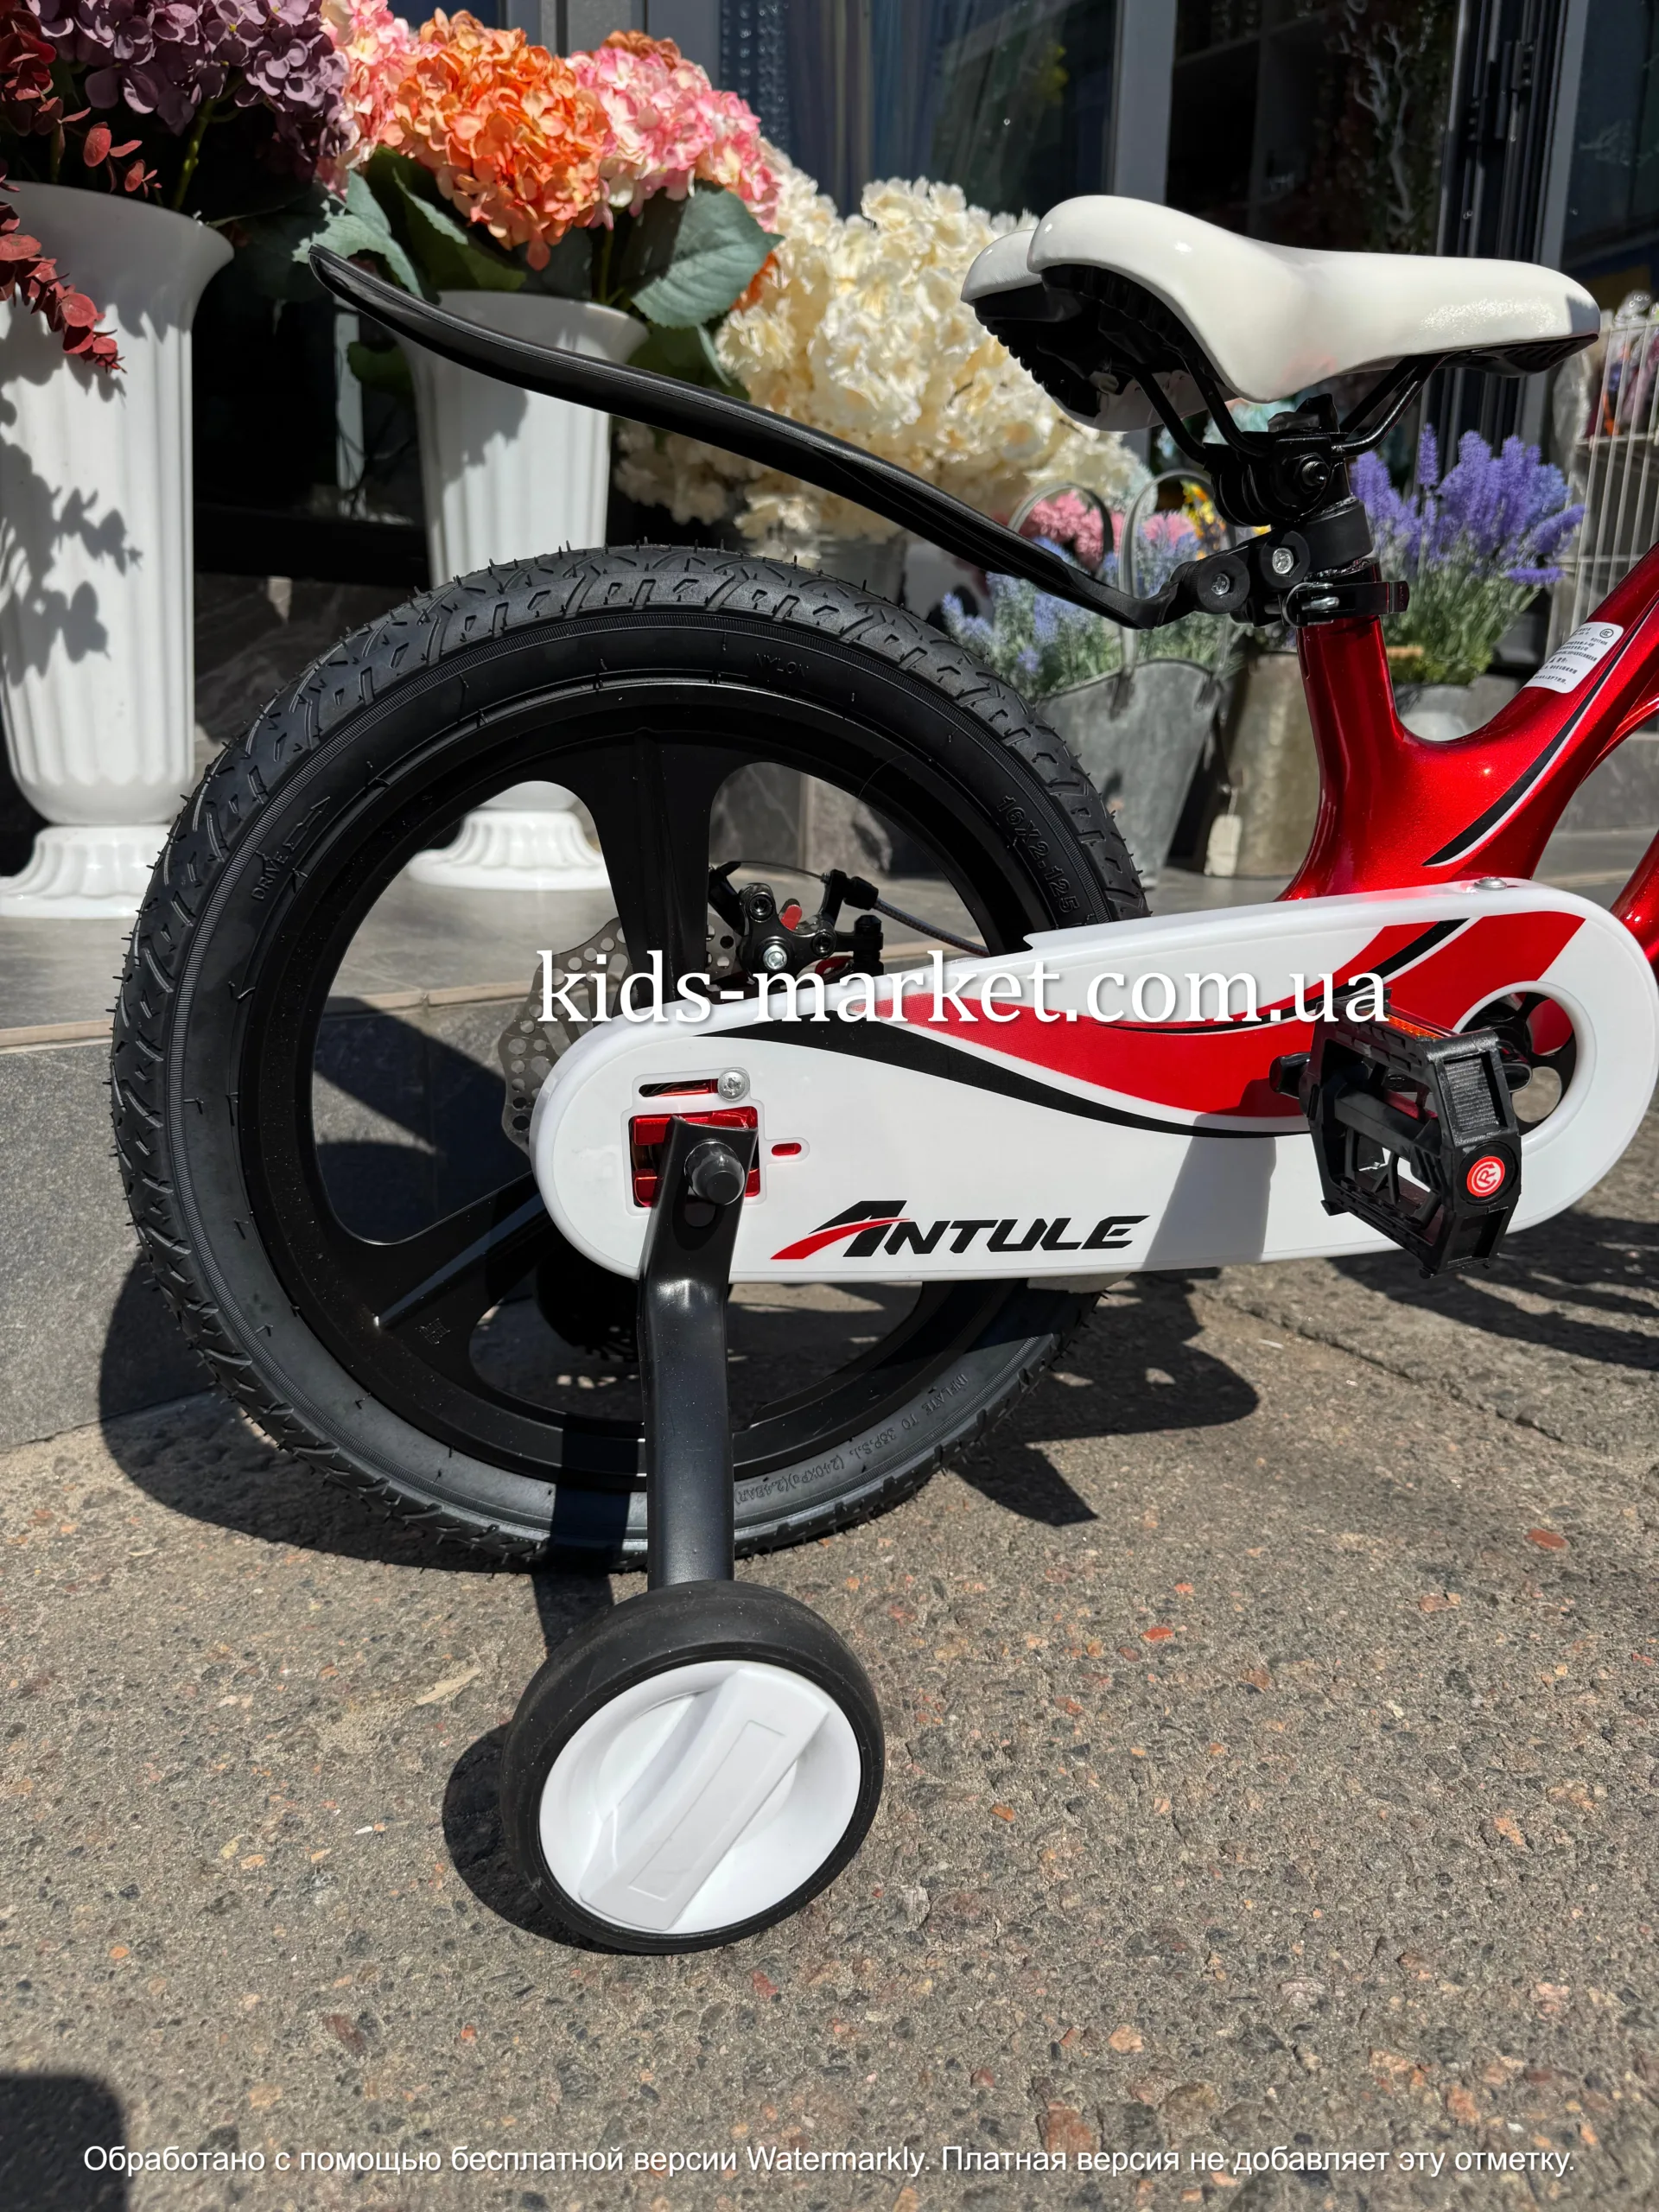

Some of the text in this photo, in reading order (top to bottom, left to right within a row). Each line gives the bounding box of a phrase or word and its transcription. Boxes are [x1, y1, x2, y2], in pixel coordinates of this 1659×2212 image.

[754, 653, 809, 677] NYLON
[251, 851, 289, 899] DRIVE
[996, 795, 1080, 913] 16X2.125
[770, 1199, 1151, 1261] ANTULE
[920, 1373, 969, 1416] INFLATE
[901, 1413, 919, 1430] TO
